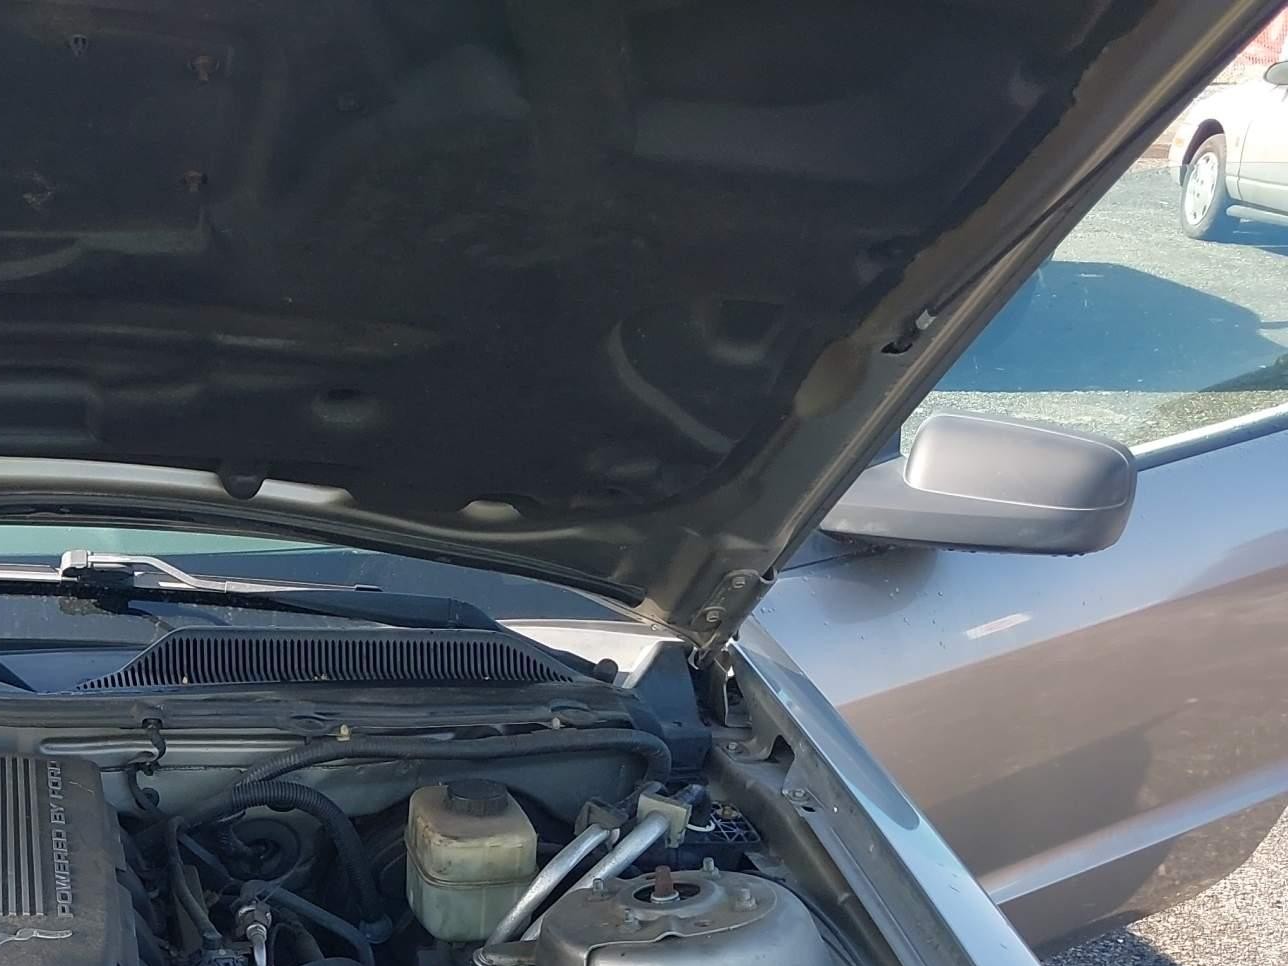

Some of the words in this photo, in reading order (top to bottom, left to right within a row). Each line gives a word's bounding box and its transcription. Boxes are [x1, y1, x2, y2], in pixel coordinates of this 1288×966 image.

[47, 759, 64, 800] FORD
[50, 801, 66, 825] BY
[52, 828, 74, 919] POWERED
